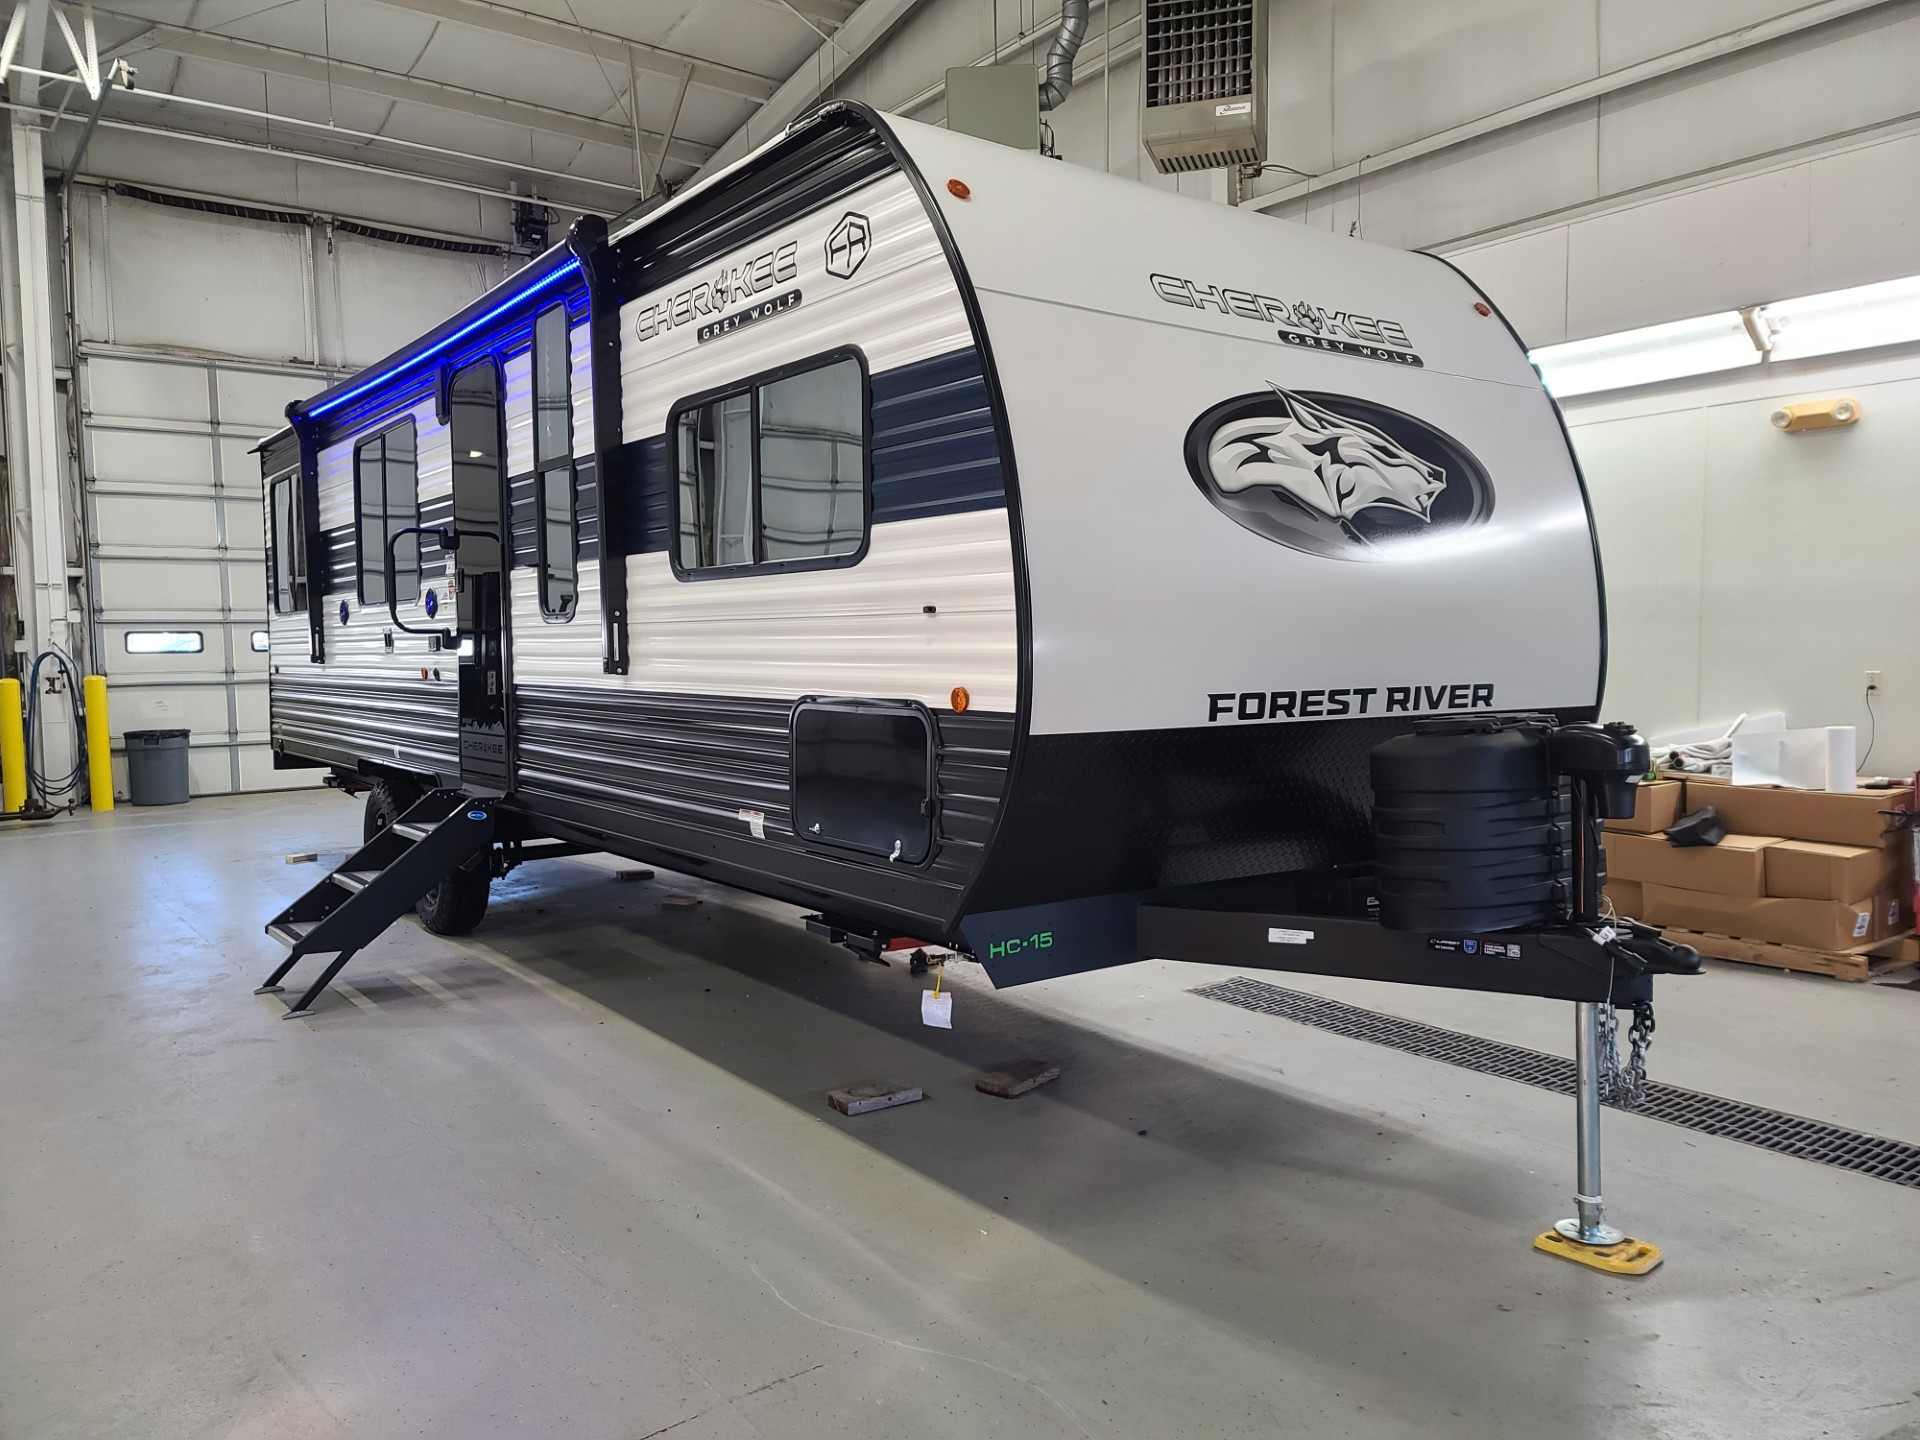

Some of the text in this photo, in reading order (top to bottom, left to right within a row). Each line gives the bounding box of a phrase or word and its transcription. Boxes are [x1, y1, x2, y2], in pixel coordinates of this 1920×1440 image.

[702, 293, 796, 341] GREY WOLF
[1288, 333, 1415, 364] GREY WOLF
[1206, 683, 1495, 723] FOREST RIVER
